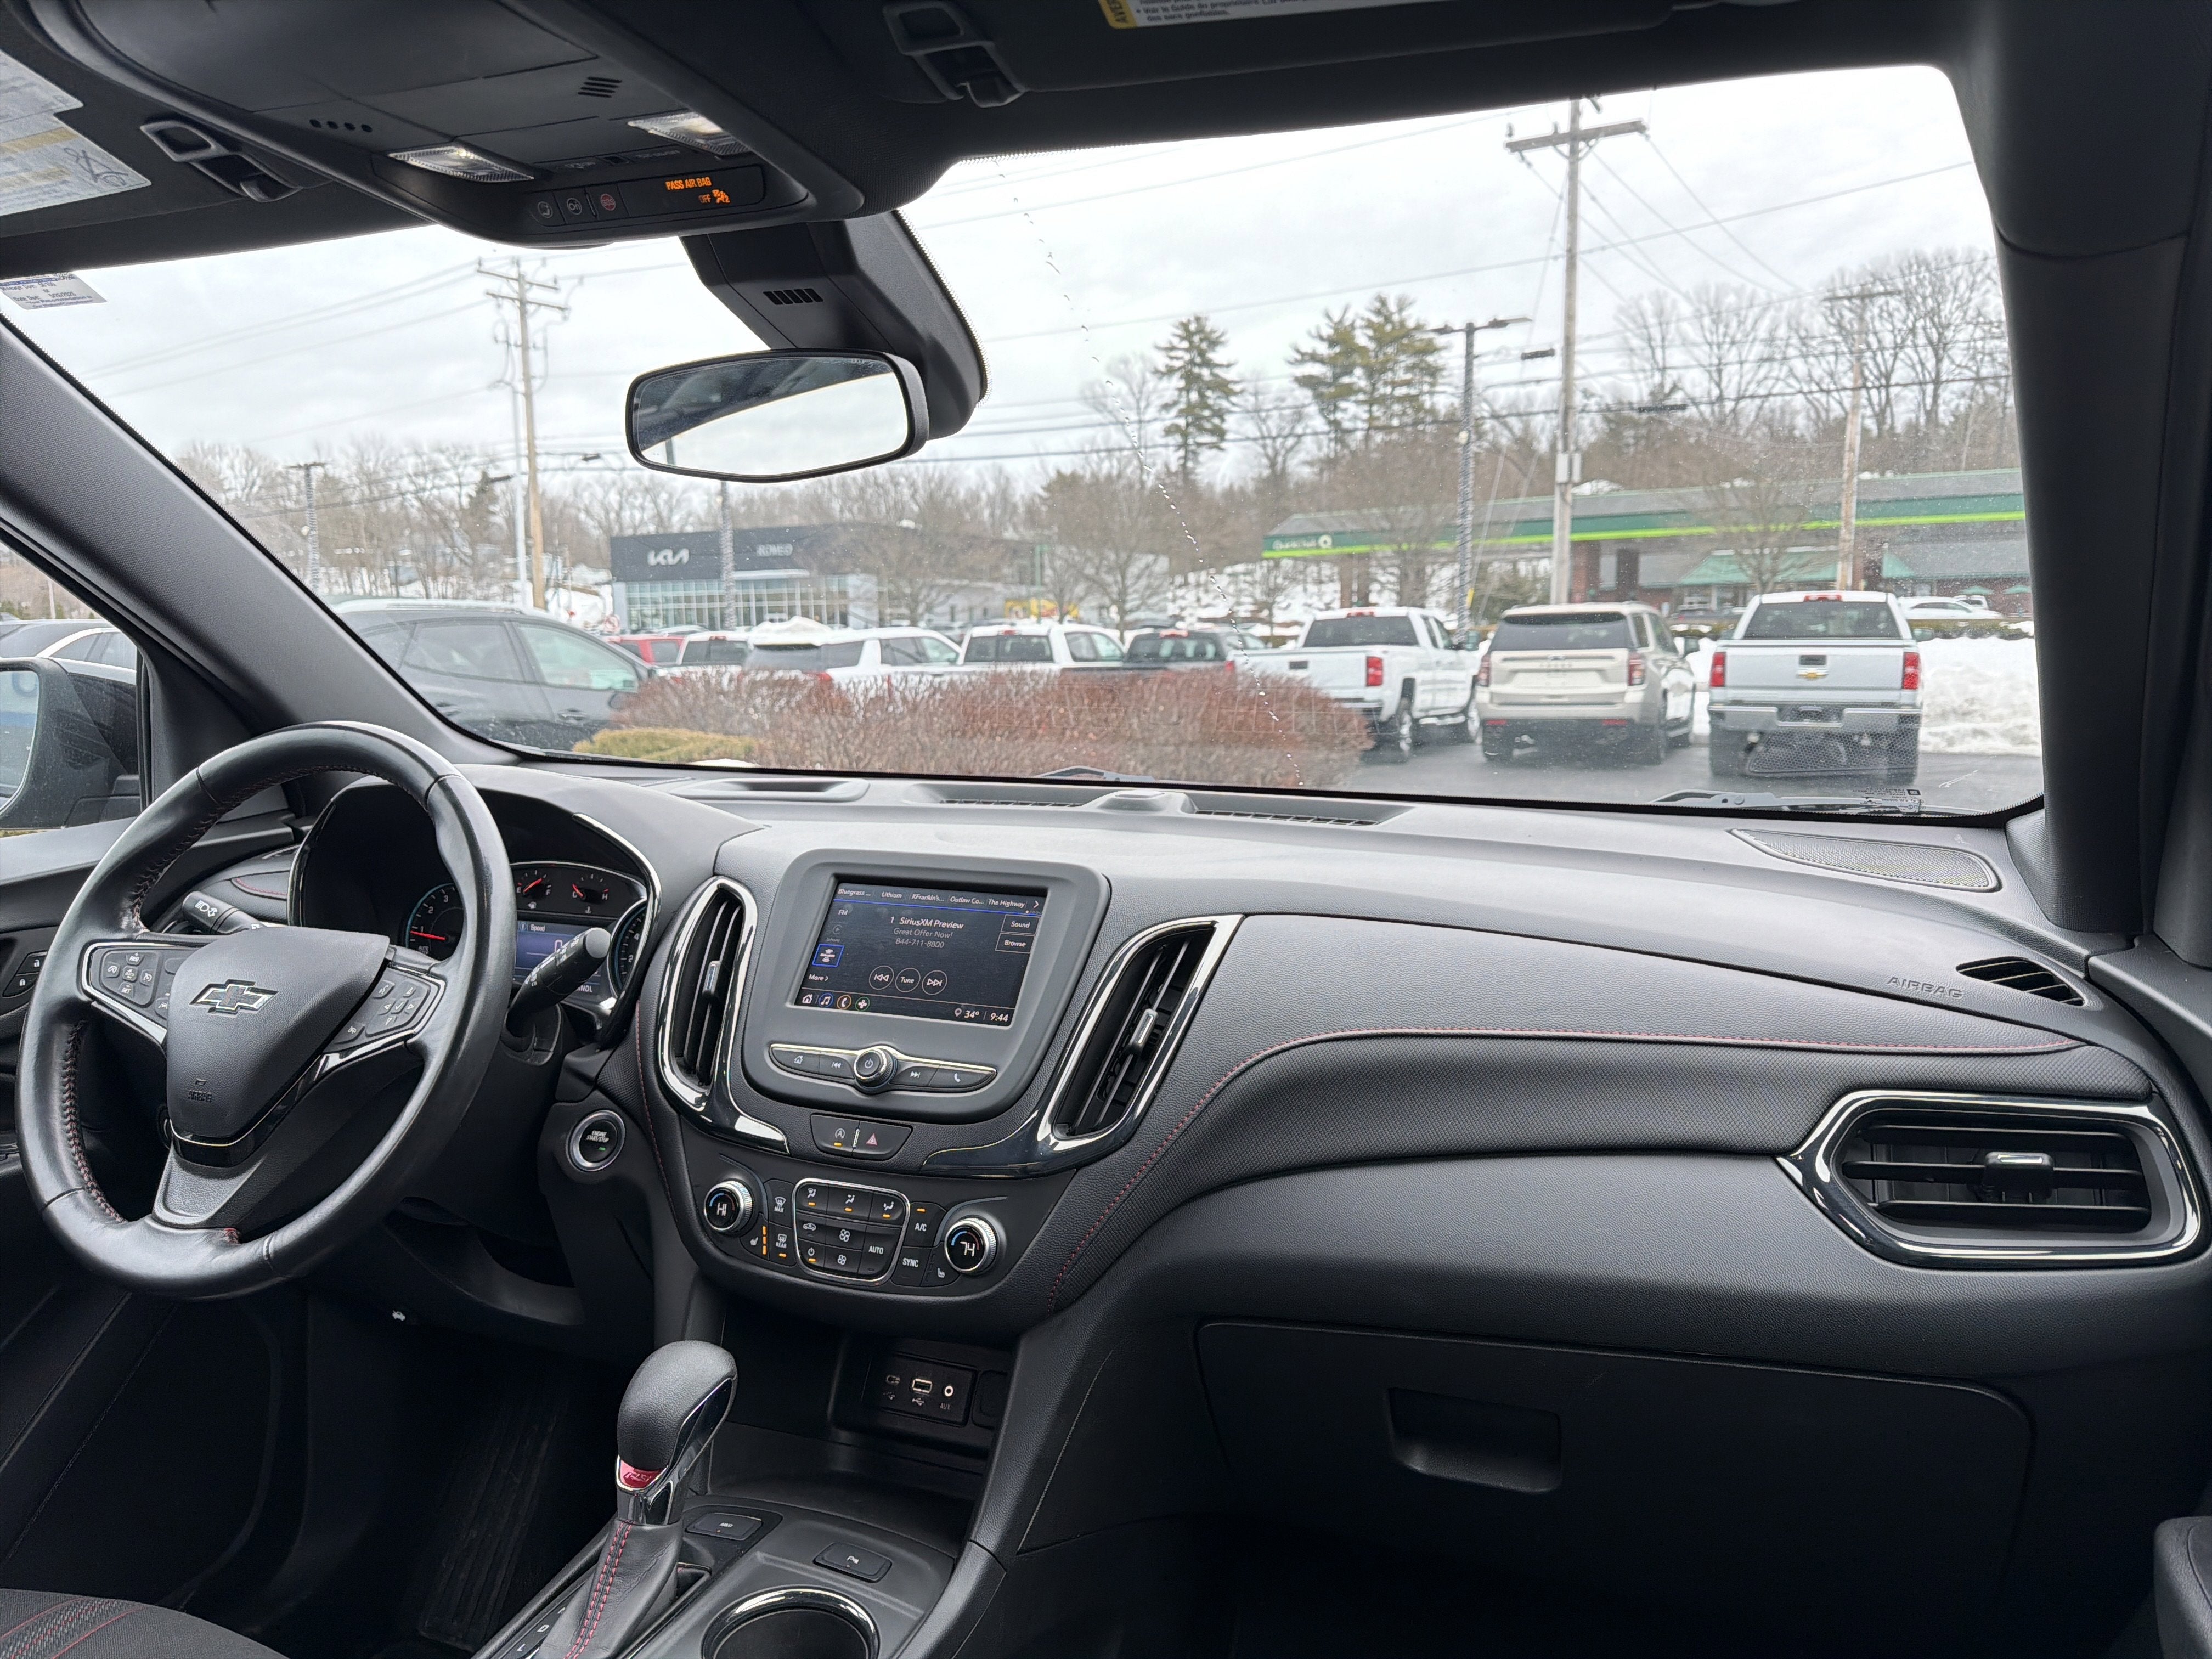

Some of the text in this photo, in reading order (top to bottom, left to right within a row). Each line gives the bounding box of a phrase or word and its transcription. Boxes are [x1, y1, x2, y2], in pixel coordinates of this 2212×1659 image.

[665, 176, 712, 190] PASS AIR BAG
[698, 194, 712, 203] OFF
[647, 548, 690, 566] KIA
[1000, 900, 1026, 909] Highway
[530, 923, 545, 932] Speed
[899, 917, 933, 927] SiriusXM
[934, 919, 964, 929] Preview
[893, 927, 912, 935] Great
[914, 929, 933, 937] Offer
[895, 938, 945, 949] 844-711-8800
[1004, 939, 1026, 947] Browse
[1887, 976, 1962, 998] AIRBAG
[990, 1012, 1009, 1022] 9:44
[188, 1089, 213, 1103] AIRBAG
[716, 1202, 727, 1217] HI
[915, 1222, 927, 1232] A/C
[868, 1245, 884, 1255] AUTO
[960, 1240, 976, 1257] 74
[902, 1257, 919, 1268] SYNC
[939, 1402, 951, 1410] AUX
[537, 1624, 550, 1633] D
[517, 1643, 526, 1651] L
